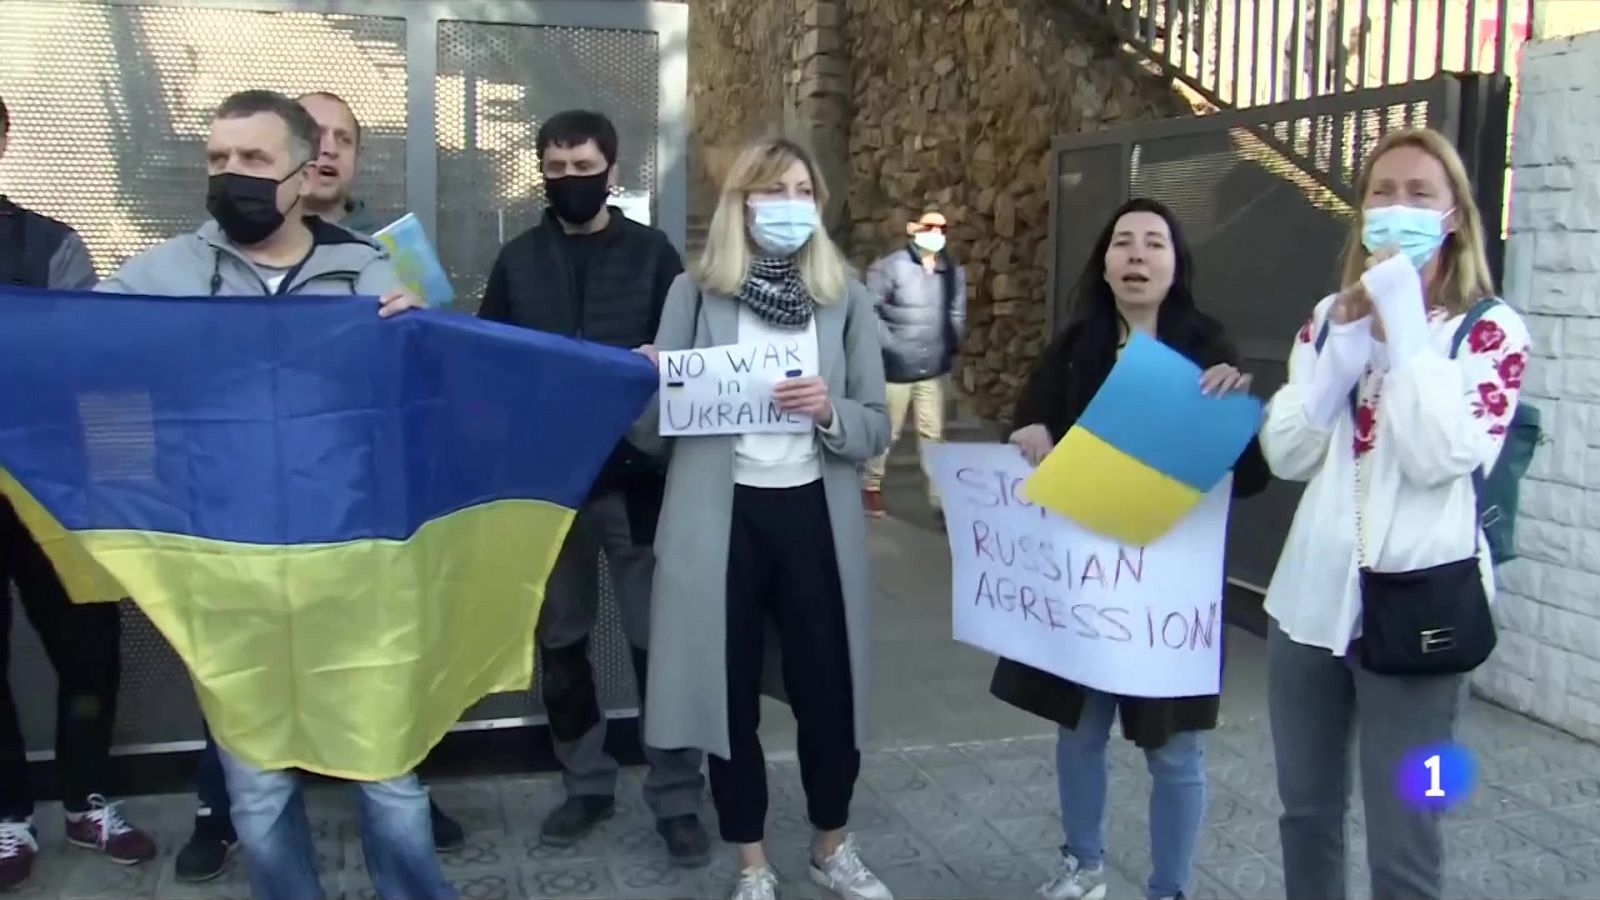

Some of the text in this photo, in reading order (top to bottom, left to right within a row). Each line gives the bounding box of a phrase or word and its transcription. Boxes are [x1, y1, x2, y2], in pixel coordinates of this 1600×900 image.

[667, 342, 802, 378] NO WAR
[718, 379, 740, 396] in
[956, 467, 1047, 518] STO
[973, 520, 1144, 590] RUSSIAN
[975, 571, 1217, 651] AGRESSION
